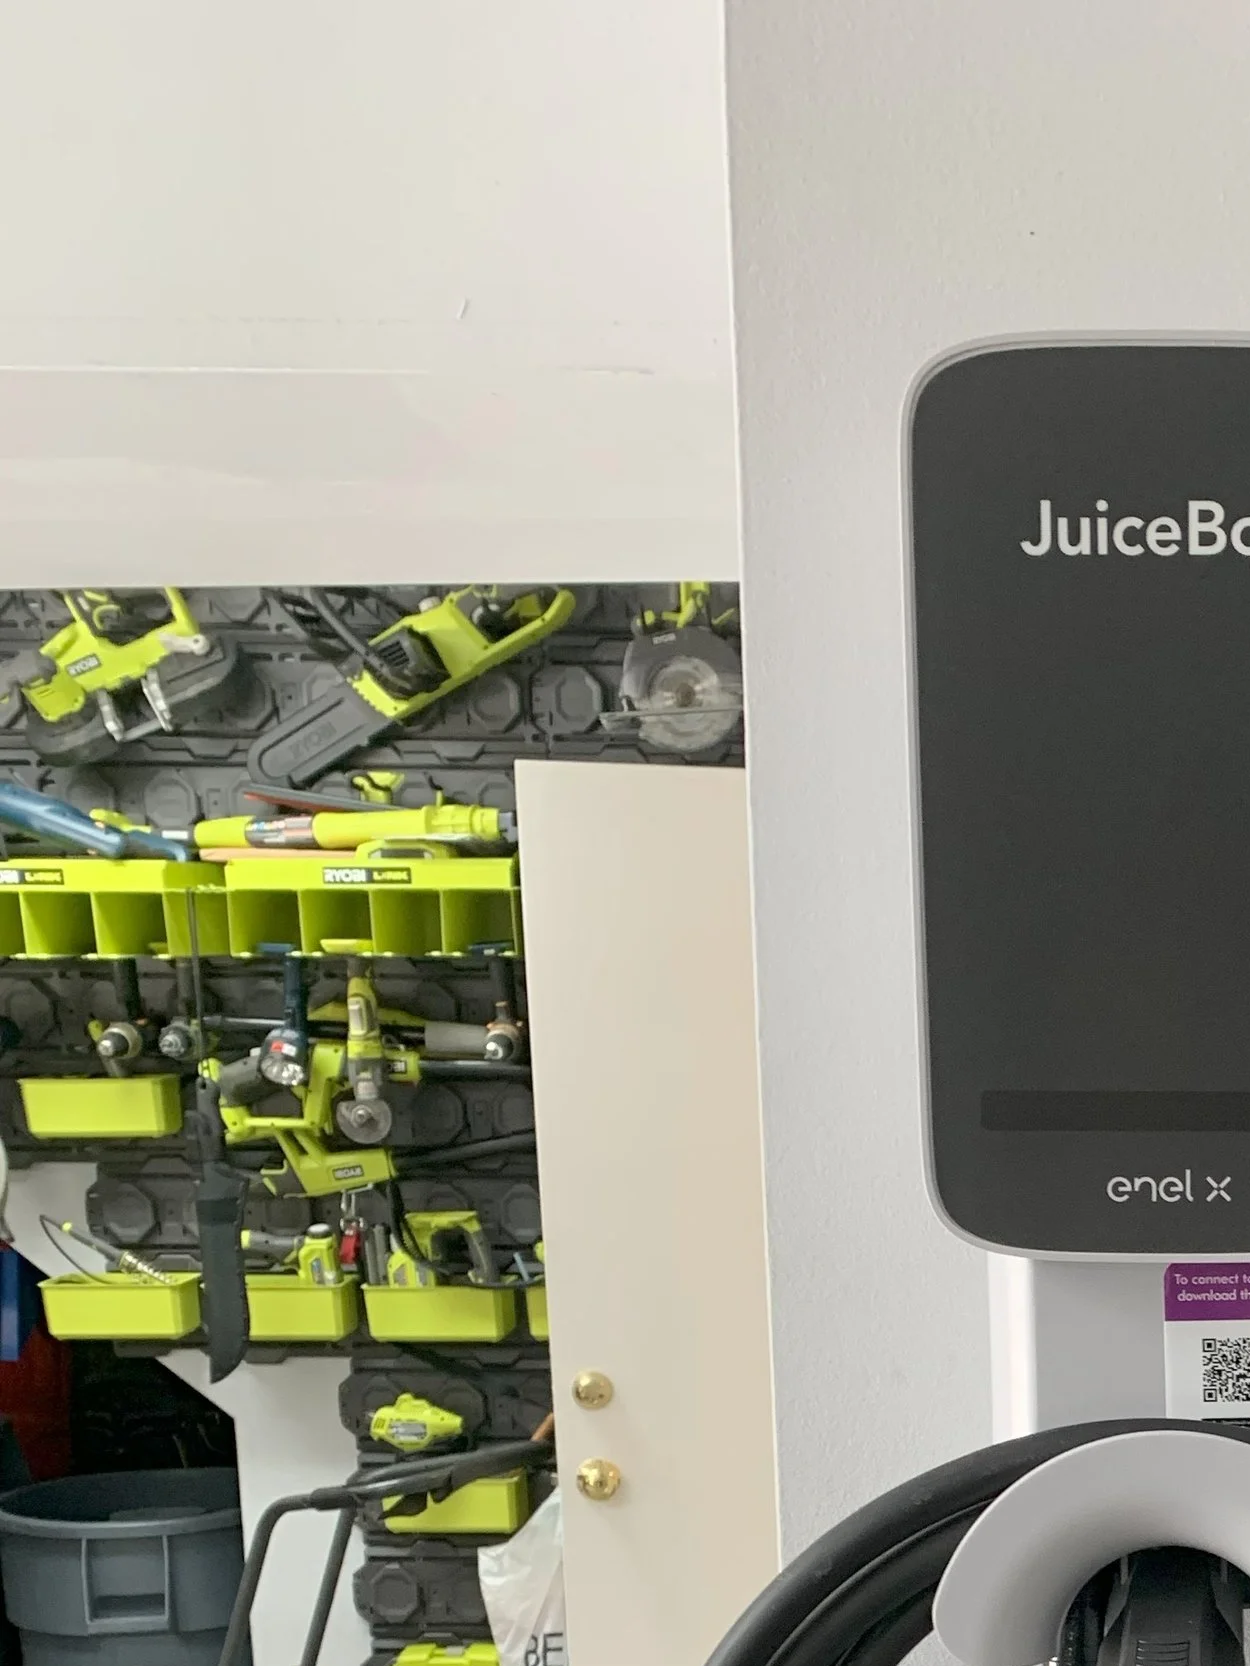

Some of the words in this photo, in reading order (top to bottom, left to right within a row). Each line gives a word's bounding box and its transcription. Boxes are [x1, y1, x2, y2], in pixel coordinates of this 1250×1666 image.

[323, 868, 367, 883] RYOBI
[1106, 1168, 1194, 1203] enel
[1174, 1273, 1188, 1286] To
[1191, 1272, 1239, 1285] connect
[1177, 1289, 1237, 1302] download
